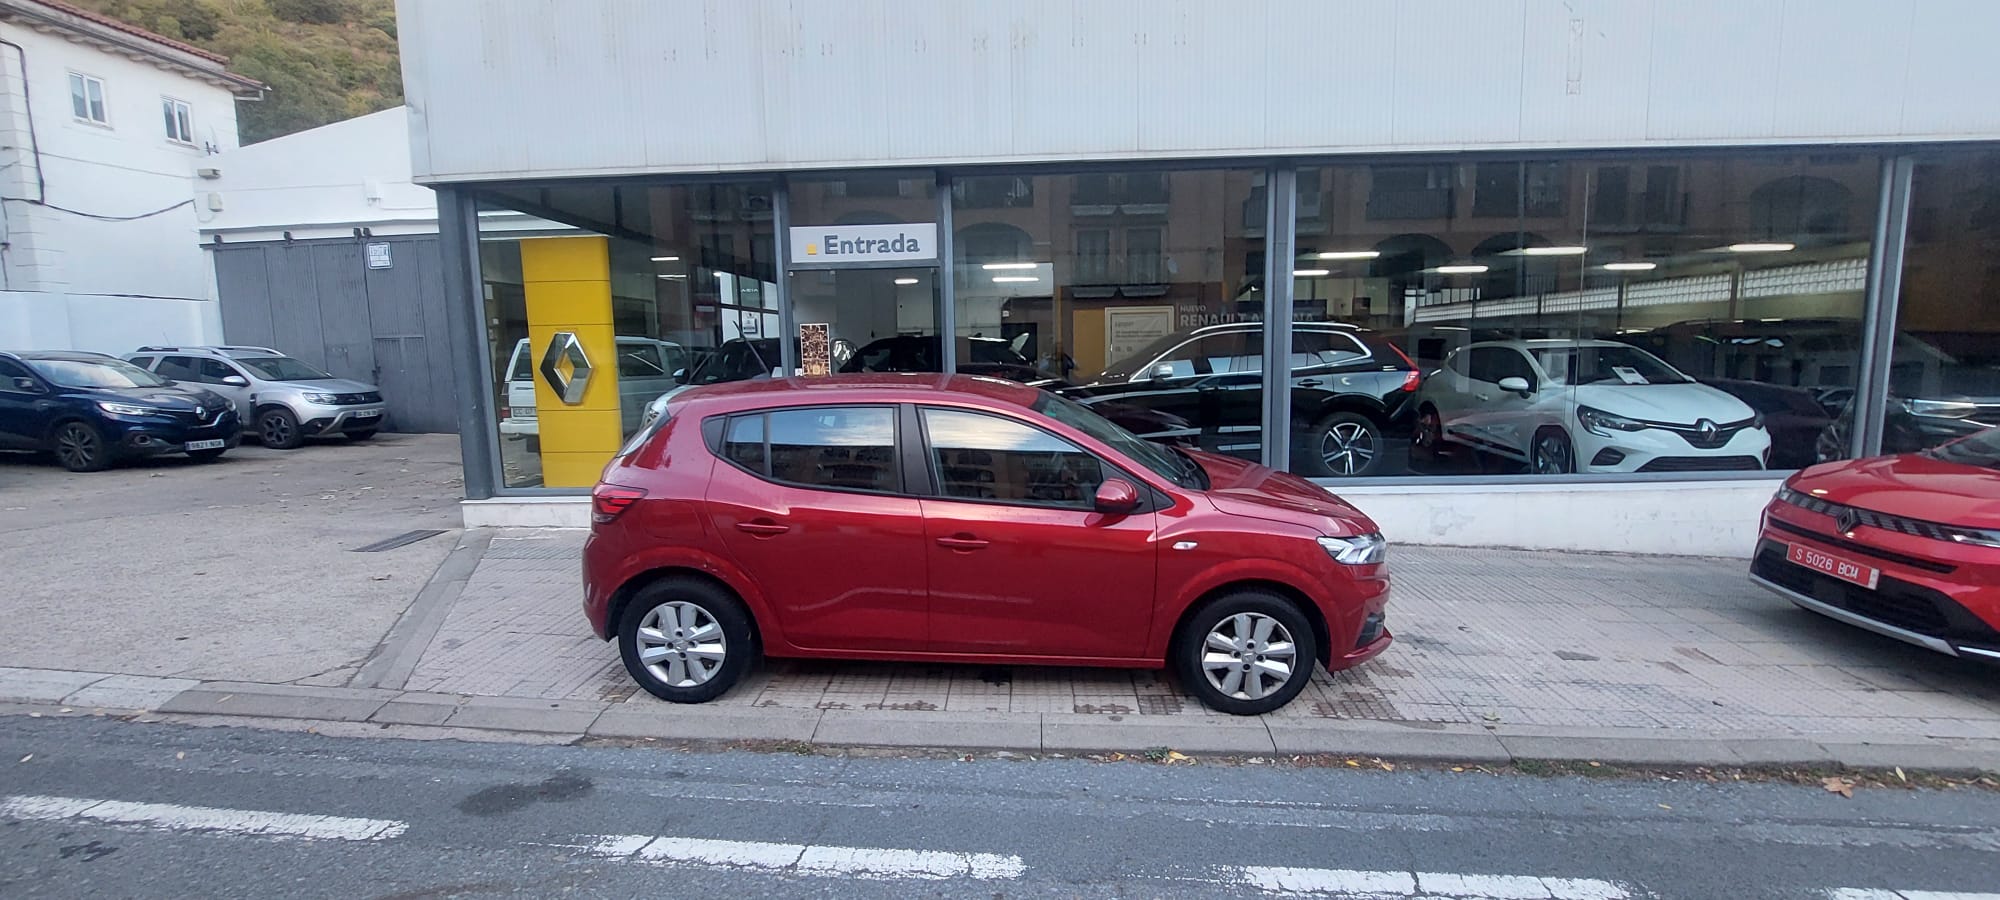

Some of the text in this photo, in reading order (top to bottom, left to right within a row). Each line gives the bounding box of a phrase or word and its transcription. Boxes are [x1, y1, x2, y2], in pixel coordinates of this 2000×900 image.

[824, 233, 921, 255] Entrada
[1180, 304, 1206, 313] NUEVO
[1795, 548, 1803, 561] S
[1805, 551, 1833, 570] 5026
